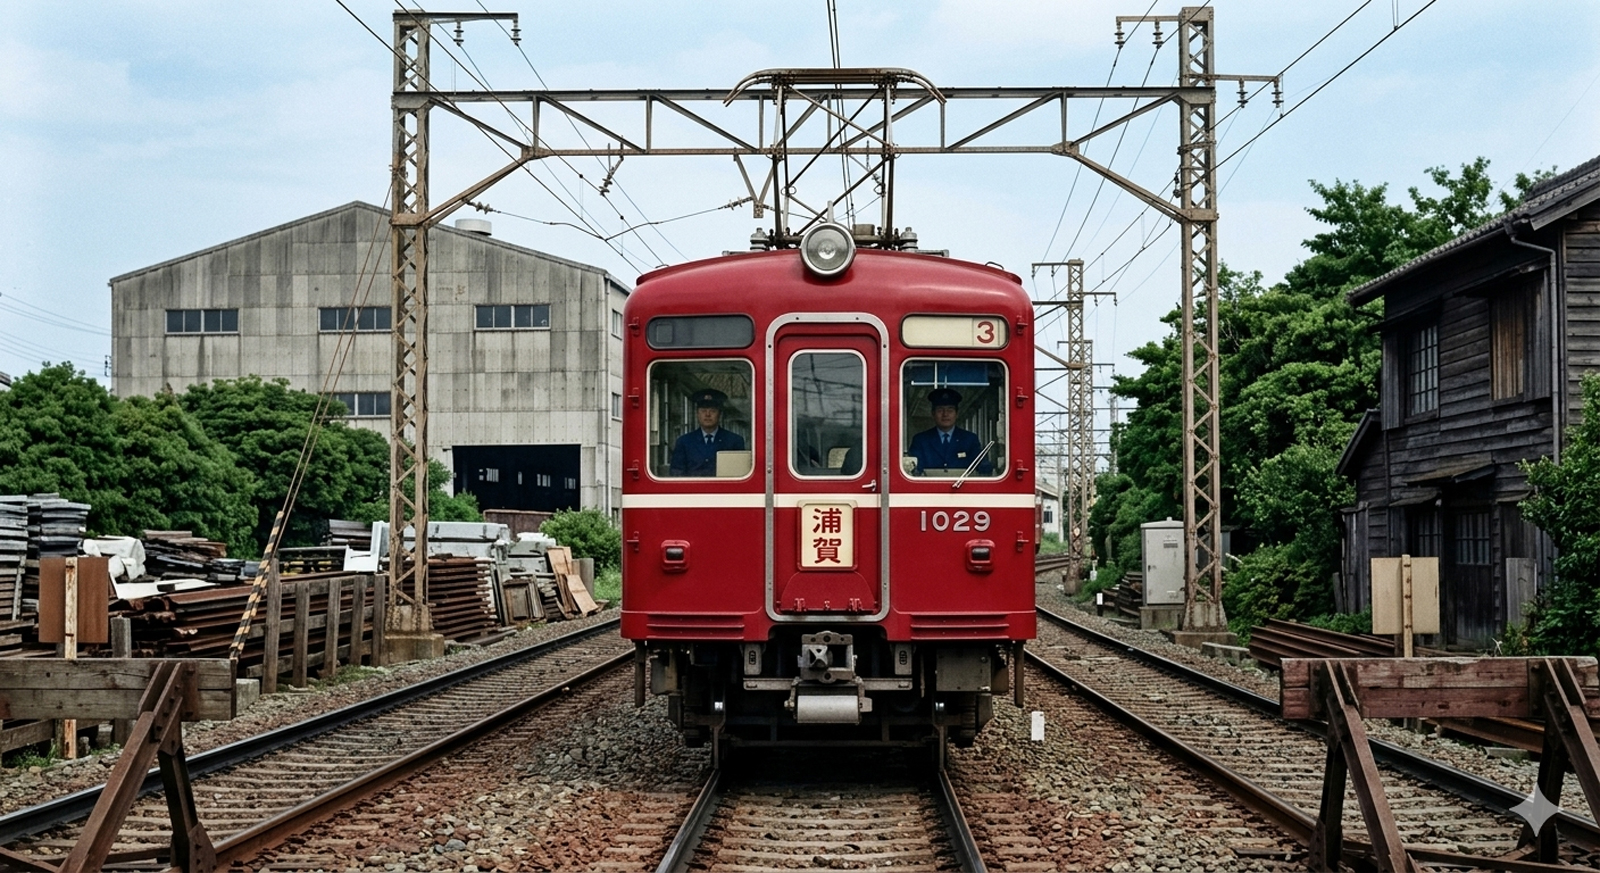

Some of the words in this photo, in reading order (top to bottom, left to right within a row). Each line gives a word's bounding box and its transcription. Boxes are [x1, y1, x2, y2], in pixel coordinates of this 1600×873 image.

[977, 321, 994, 344] 3
[921, 510, 991, 532] 1029
[813, 508, 842, 564] 浦賀
